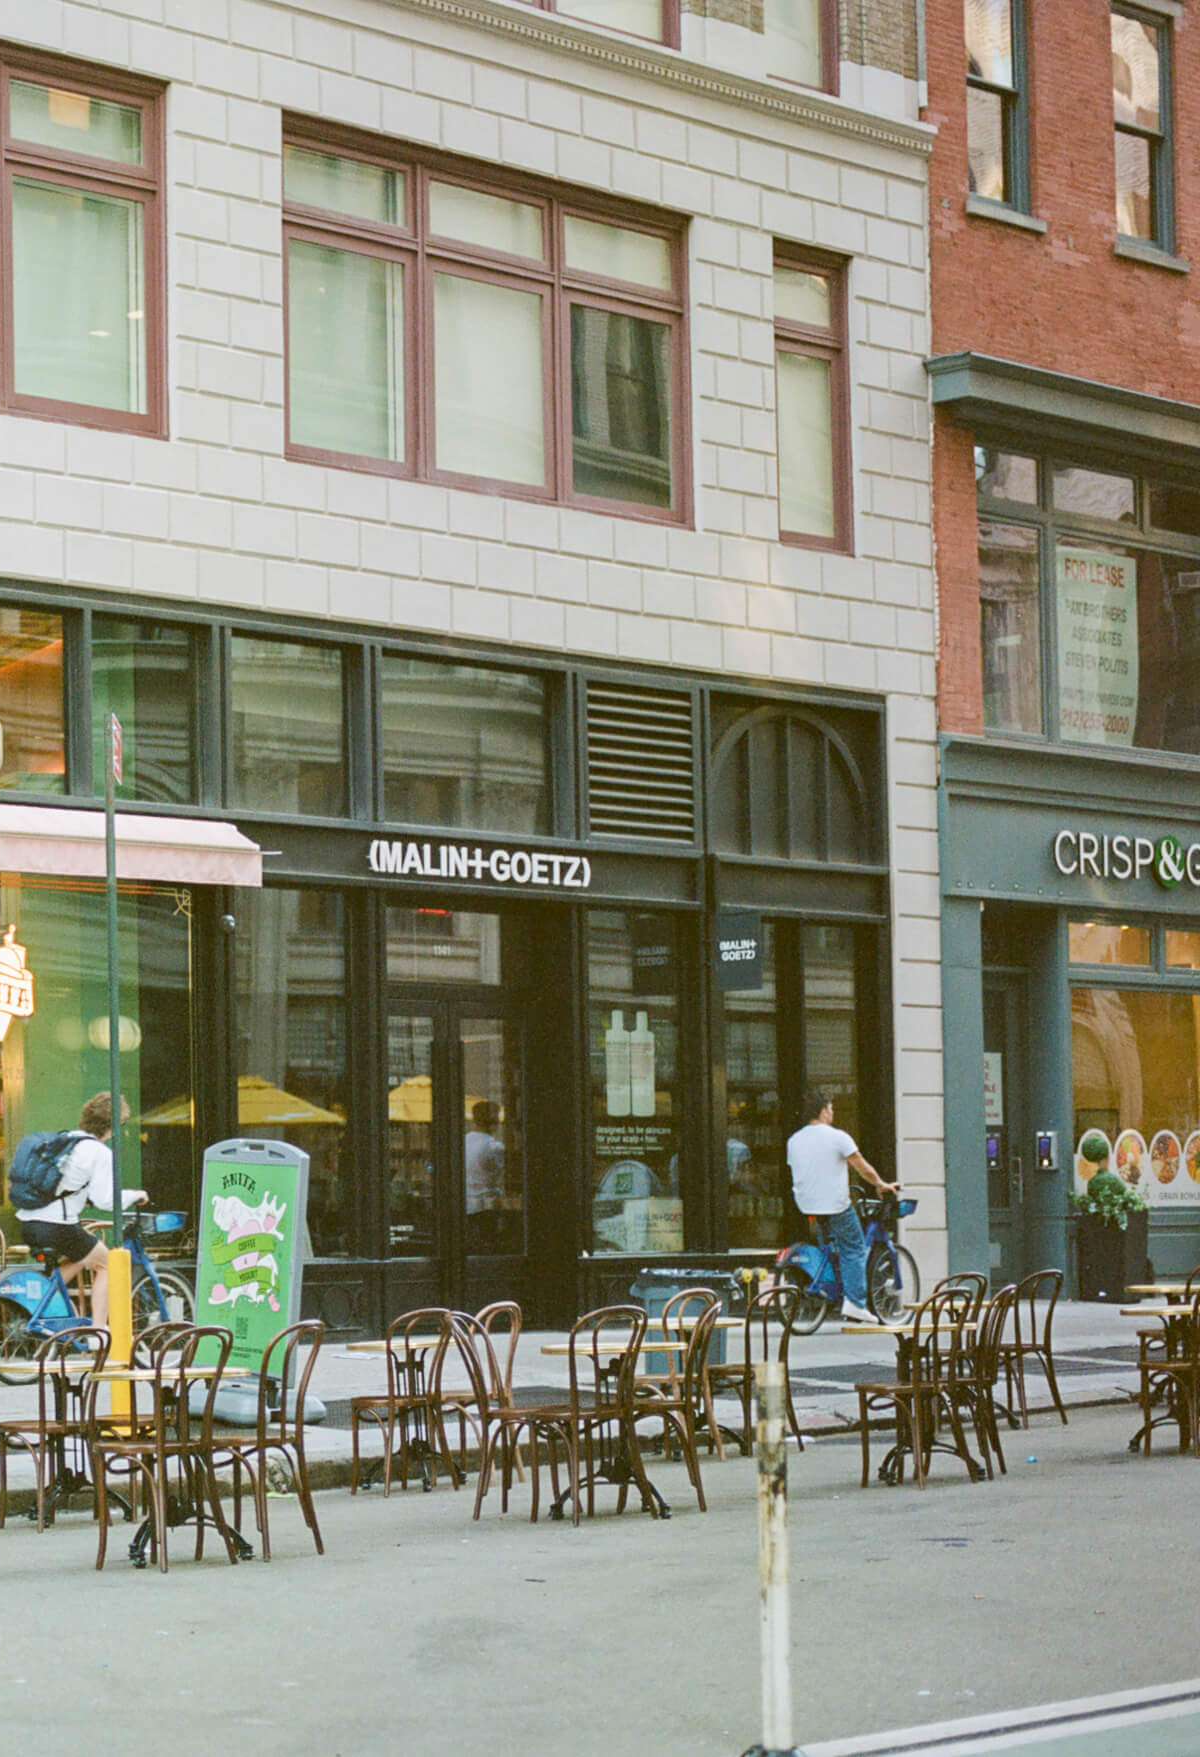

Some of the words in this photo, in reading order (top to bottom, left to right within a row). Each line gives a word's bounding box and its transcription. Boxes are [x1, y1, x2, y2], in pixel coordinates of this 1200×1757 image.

[1064, 556, 1088, 581] FOR
[1089, 561, 1126, 589] LEASE
[369, 839, 591, 888] (MALIN+GOETZ)
[222, 1172, 257, 1195] ANITA
[238, 1237, 257, 1252] COFFEE
